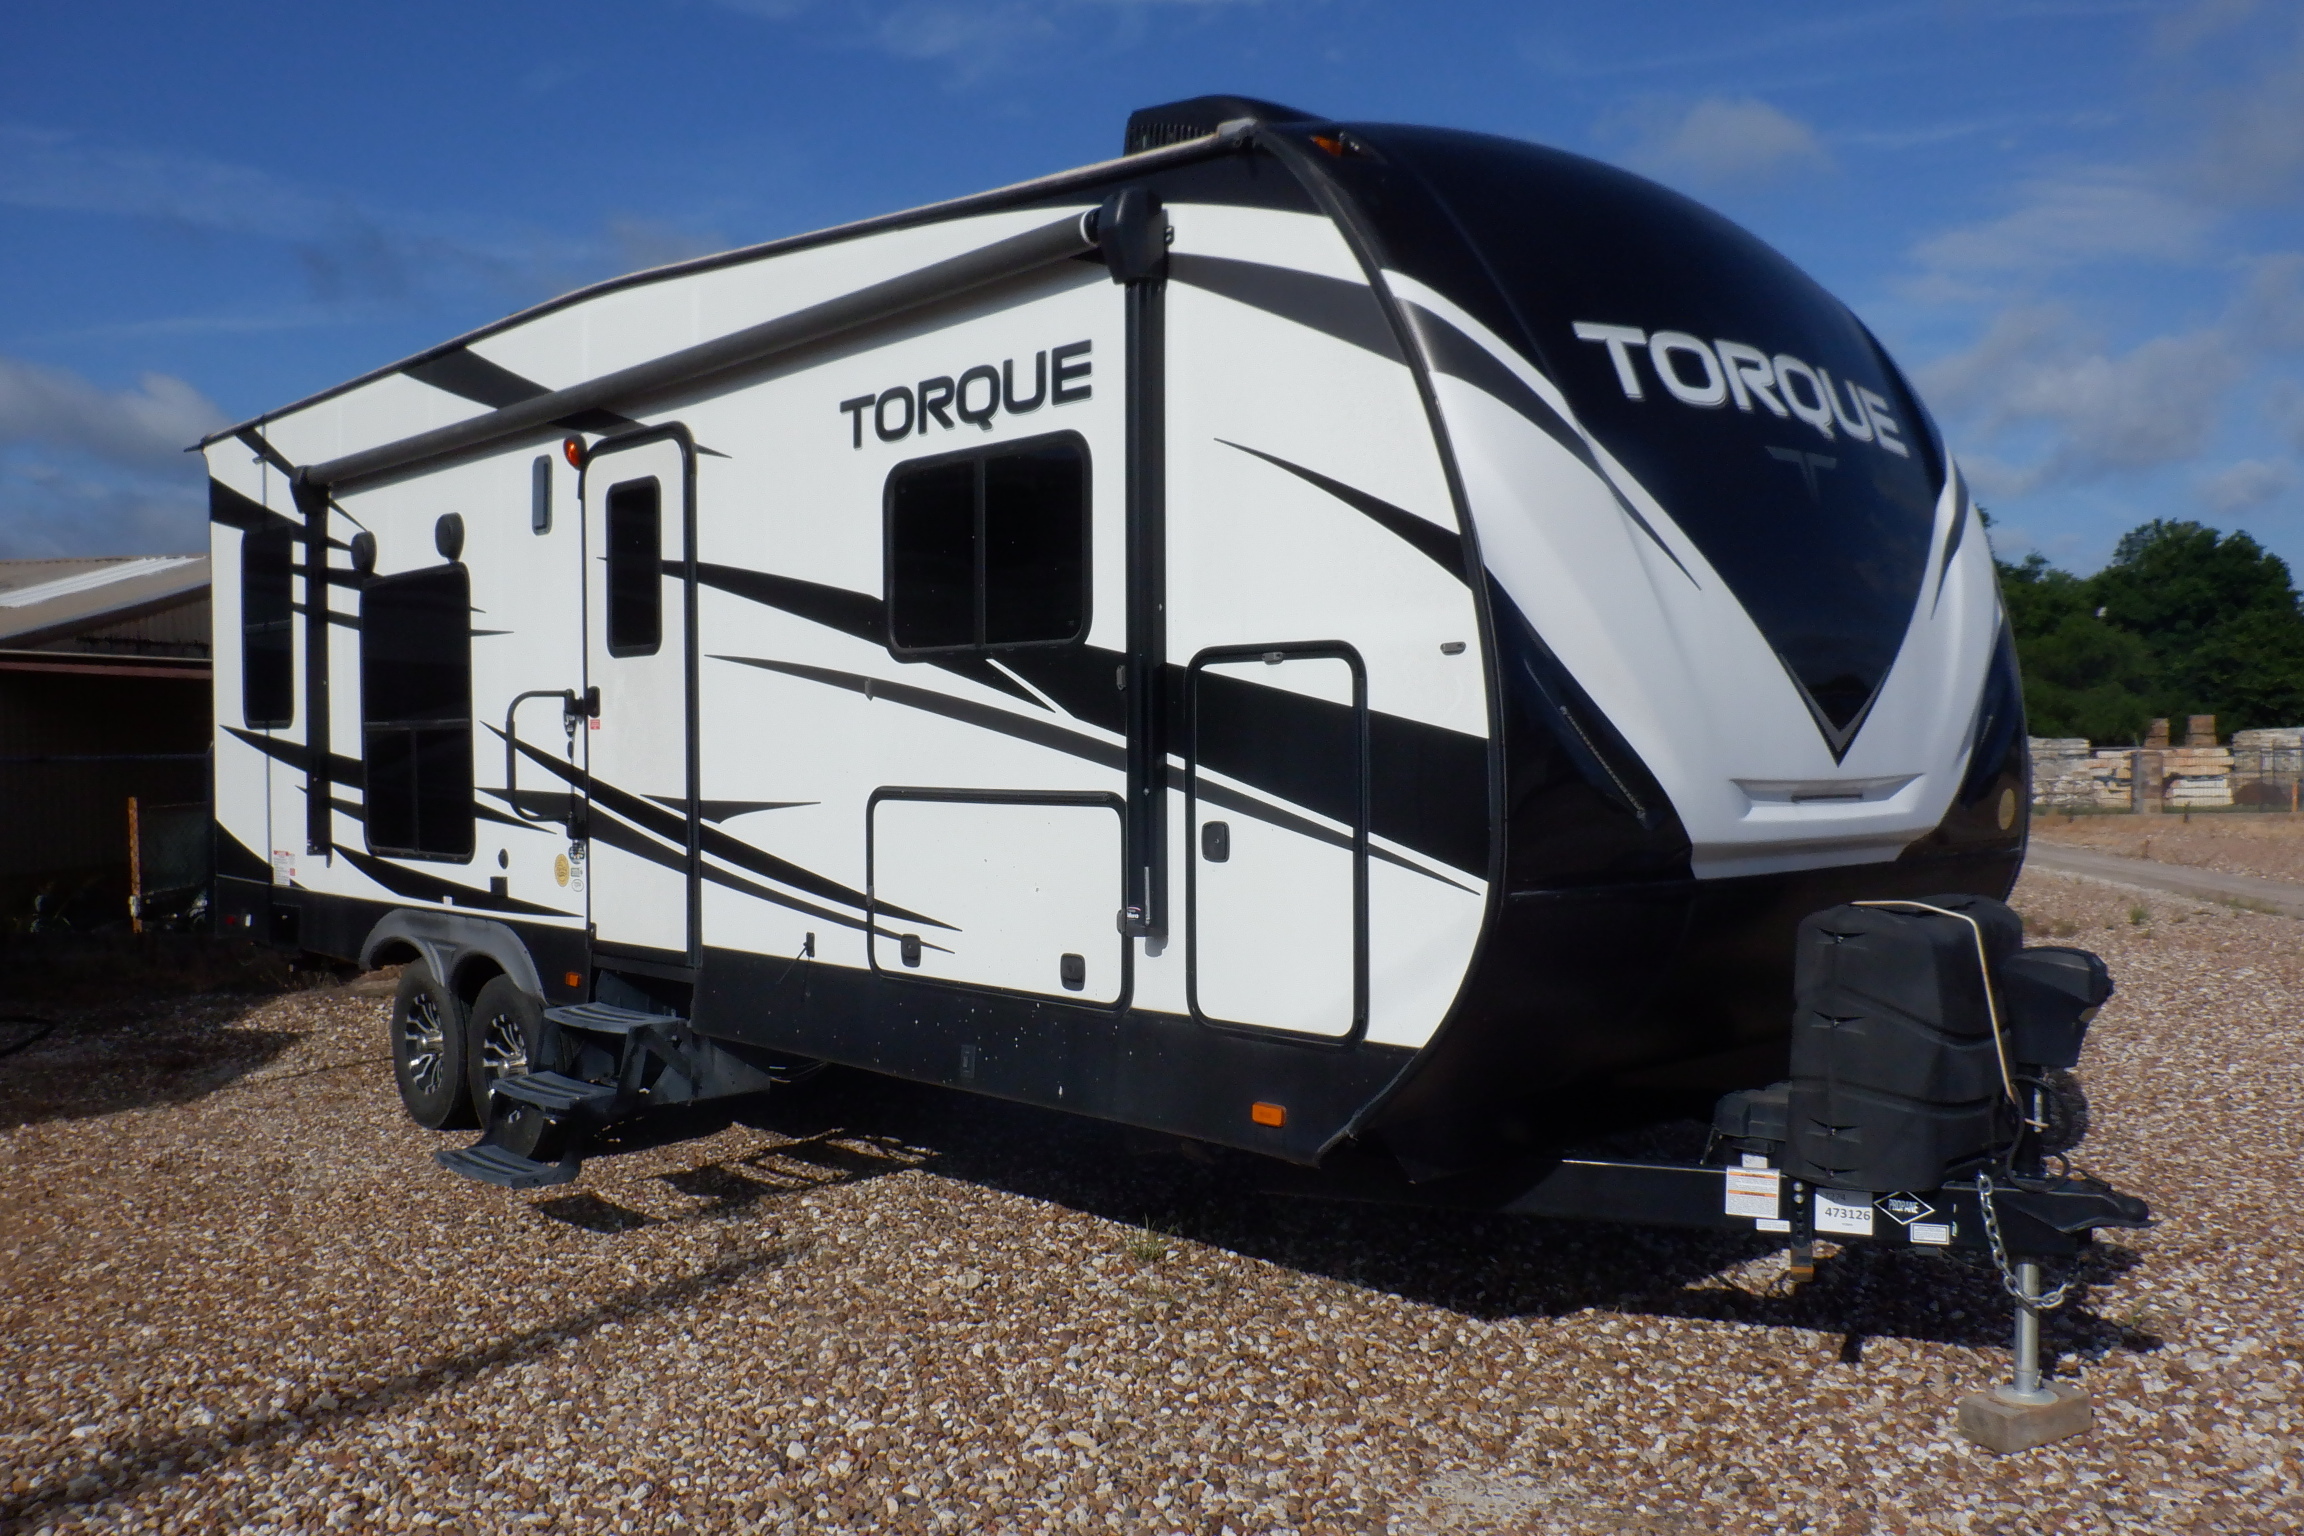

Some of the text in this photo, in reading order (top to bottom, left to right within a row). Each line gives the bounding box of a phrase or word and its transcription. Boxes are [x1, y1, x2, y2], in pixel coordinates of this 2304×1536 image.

[840, 338, 1092, 451] TORQUE
[1572, 321, 1909, 458] TORQUE
[1824, 1207, 1871, 1221] 473126
[1888, 1198, 1919, 1214] PROPANE
